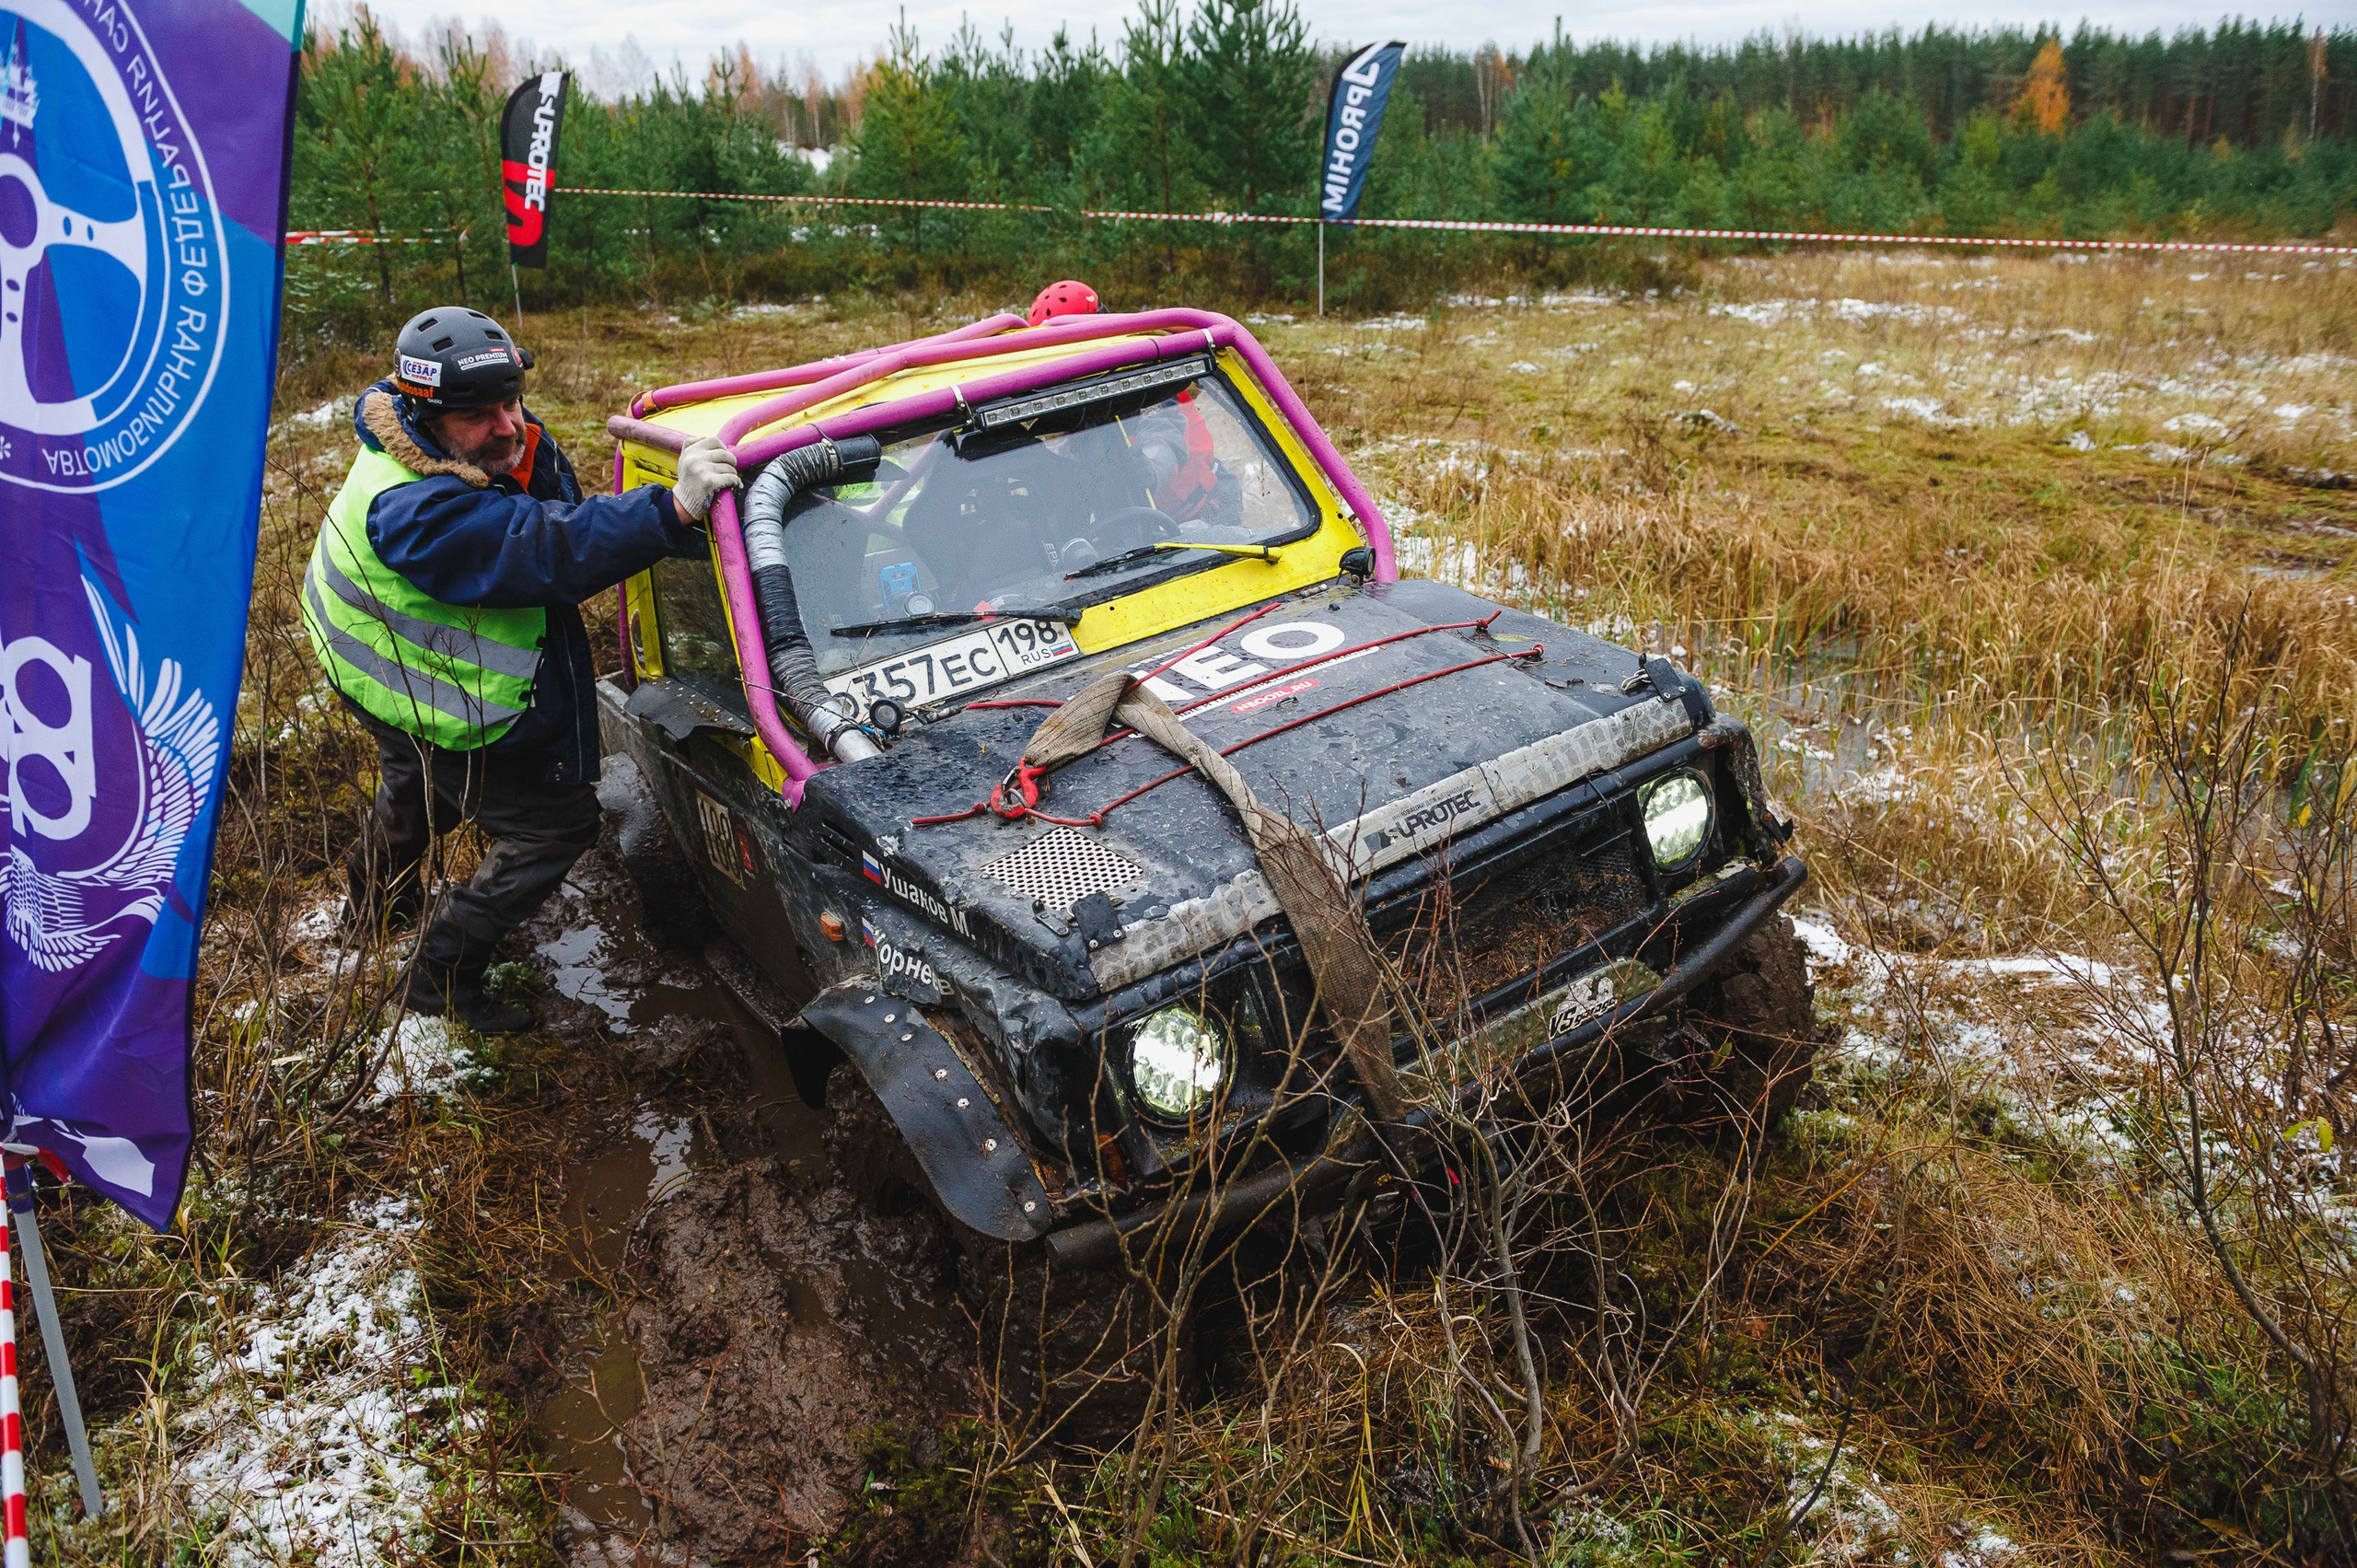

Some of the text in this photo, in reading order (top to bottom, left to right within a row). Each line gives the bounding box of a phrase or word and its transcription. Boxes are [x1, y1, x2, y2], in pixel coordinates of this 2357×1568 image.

[458, 356, 475, 366] NEO
[475, 352, 508, 362] PREMIUM
[997, 620, 1059, 656] 198
[1020, 647, 1051, 666] RUS
[880, 863, 977, 941] Ушаков М.
